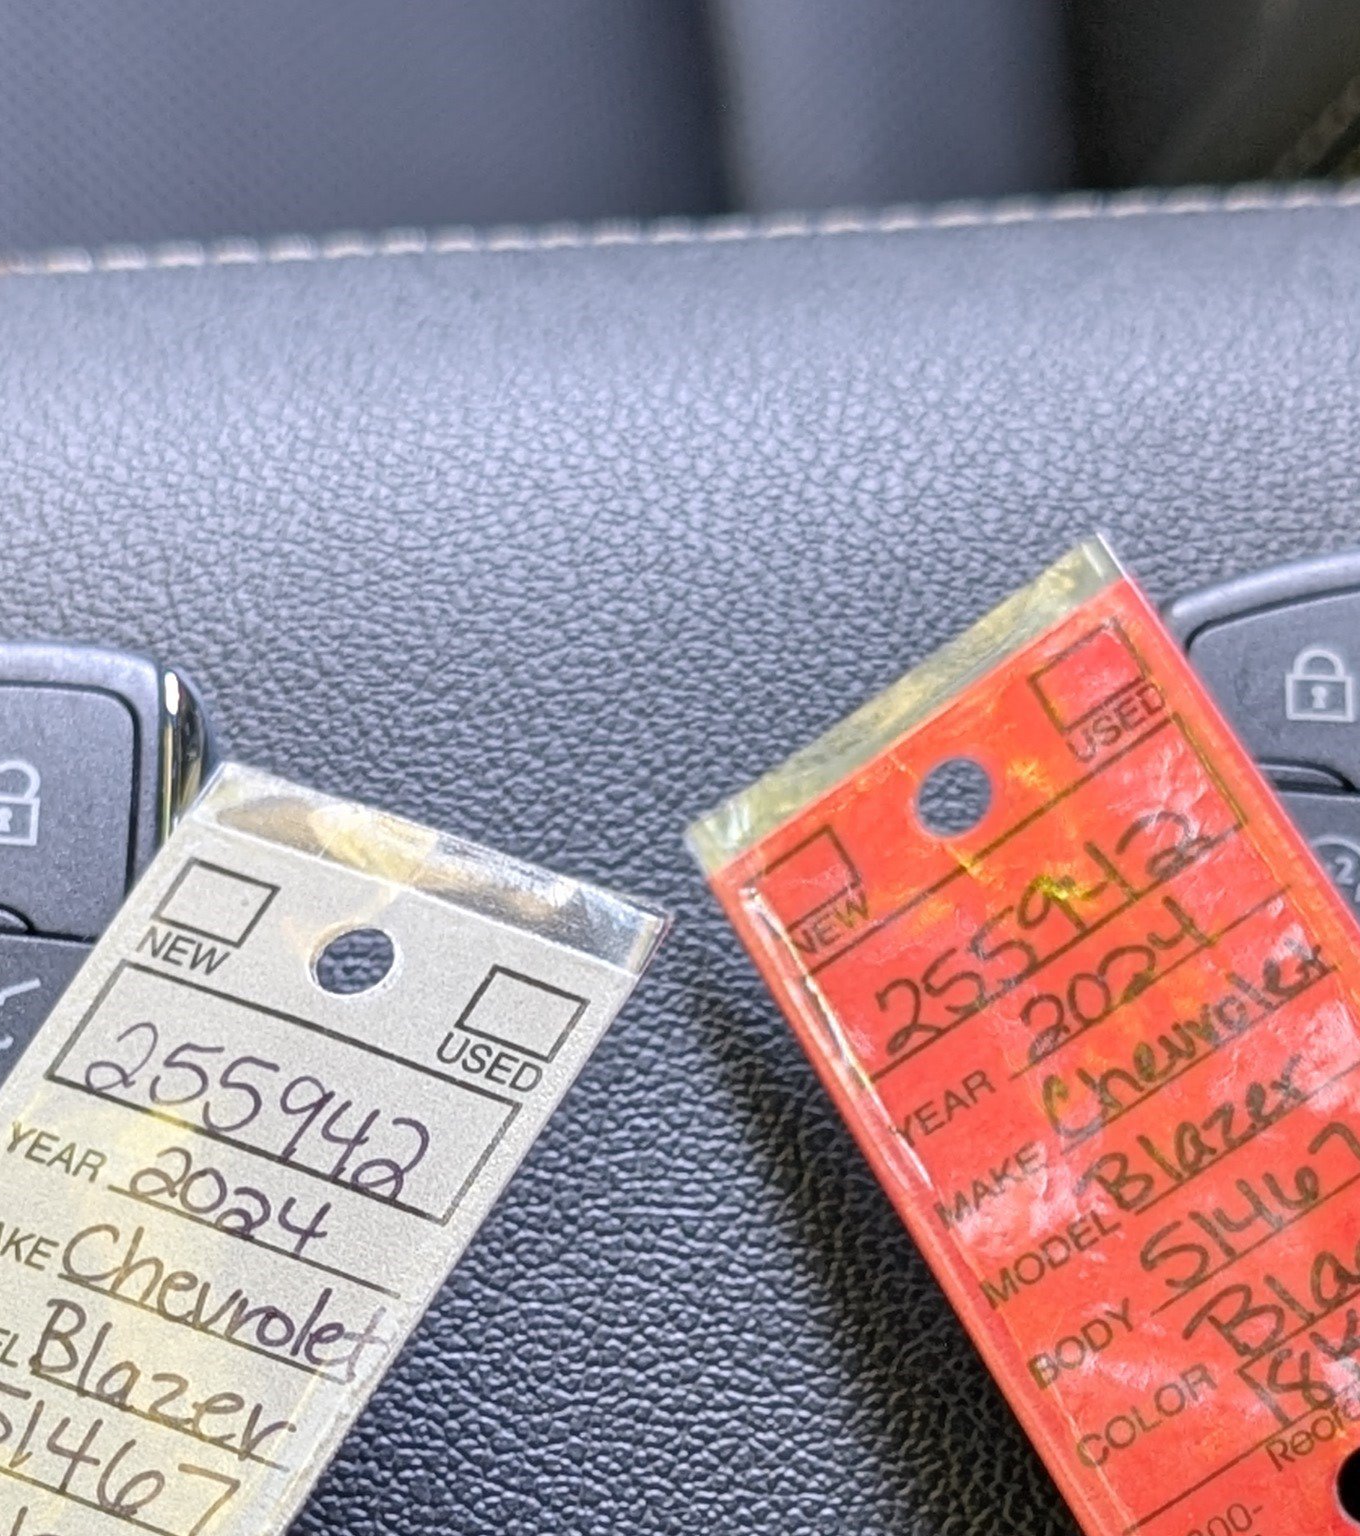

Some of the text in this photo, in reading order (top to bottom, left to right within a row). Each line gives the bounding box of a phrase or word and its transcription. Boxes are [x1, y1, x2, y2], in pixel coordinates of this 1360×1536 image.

[1066, 681, 1167, 764] USED
[136, 926, 230, 976] NEW
[794, 890, 869, 956] NEW
[875, 810, 1212, 1056] 255942
[435, 1031, 544, 1094] USED
[888, 896, 1220, 1149] YEAR 2024
[84, 1021, 430, 1201] 255942
[6, 1121, 332, 1256] YEAR 2024
[934, 1141, 1051, 1231] MAKE
[979, 1054, 1304, 1310] MODEL Blazer
[61, 1222, 389, 1384] Chevrolet
[1027, 1298, 1135, 1390] BODY
[28, 1298, 297, 1462] Blazer
[1075, 1362, 1220, 1470] COLOR
